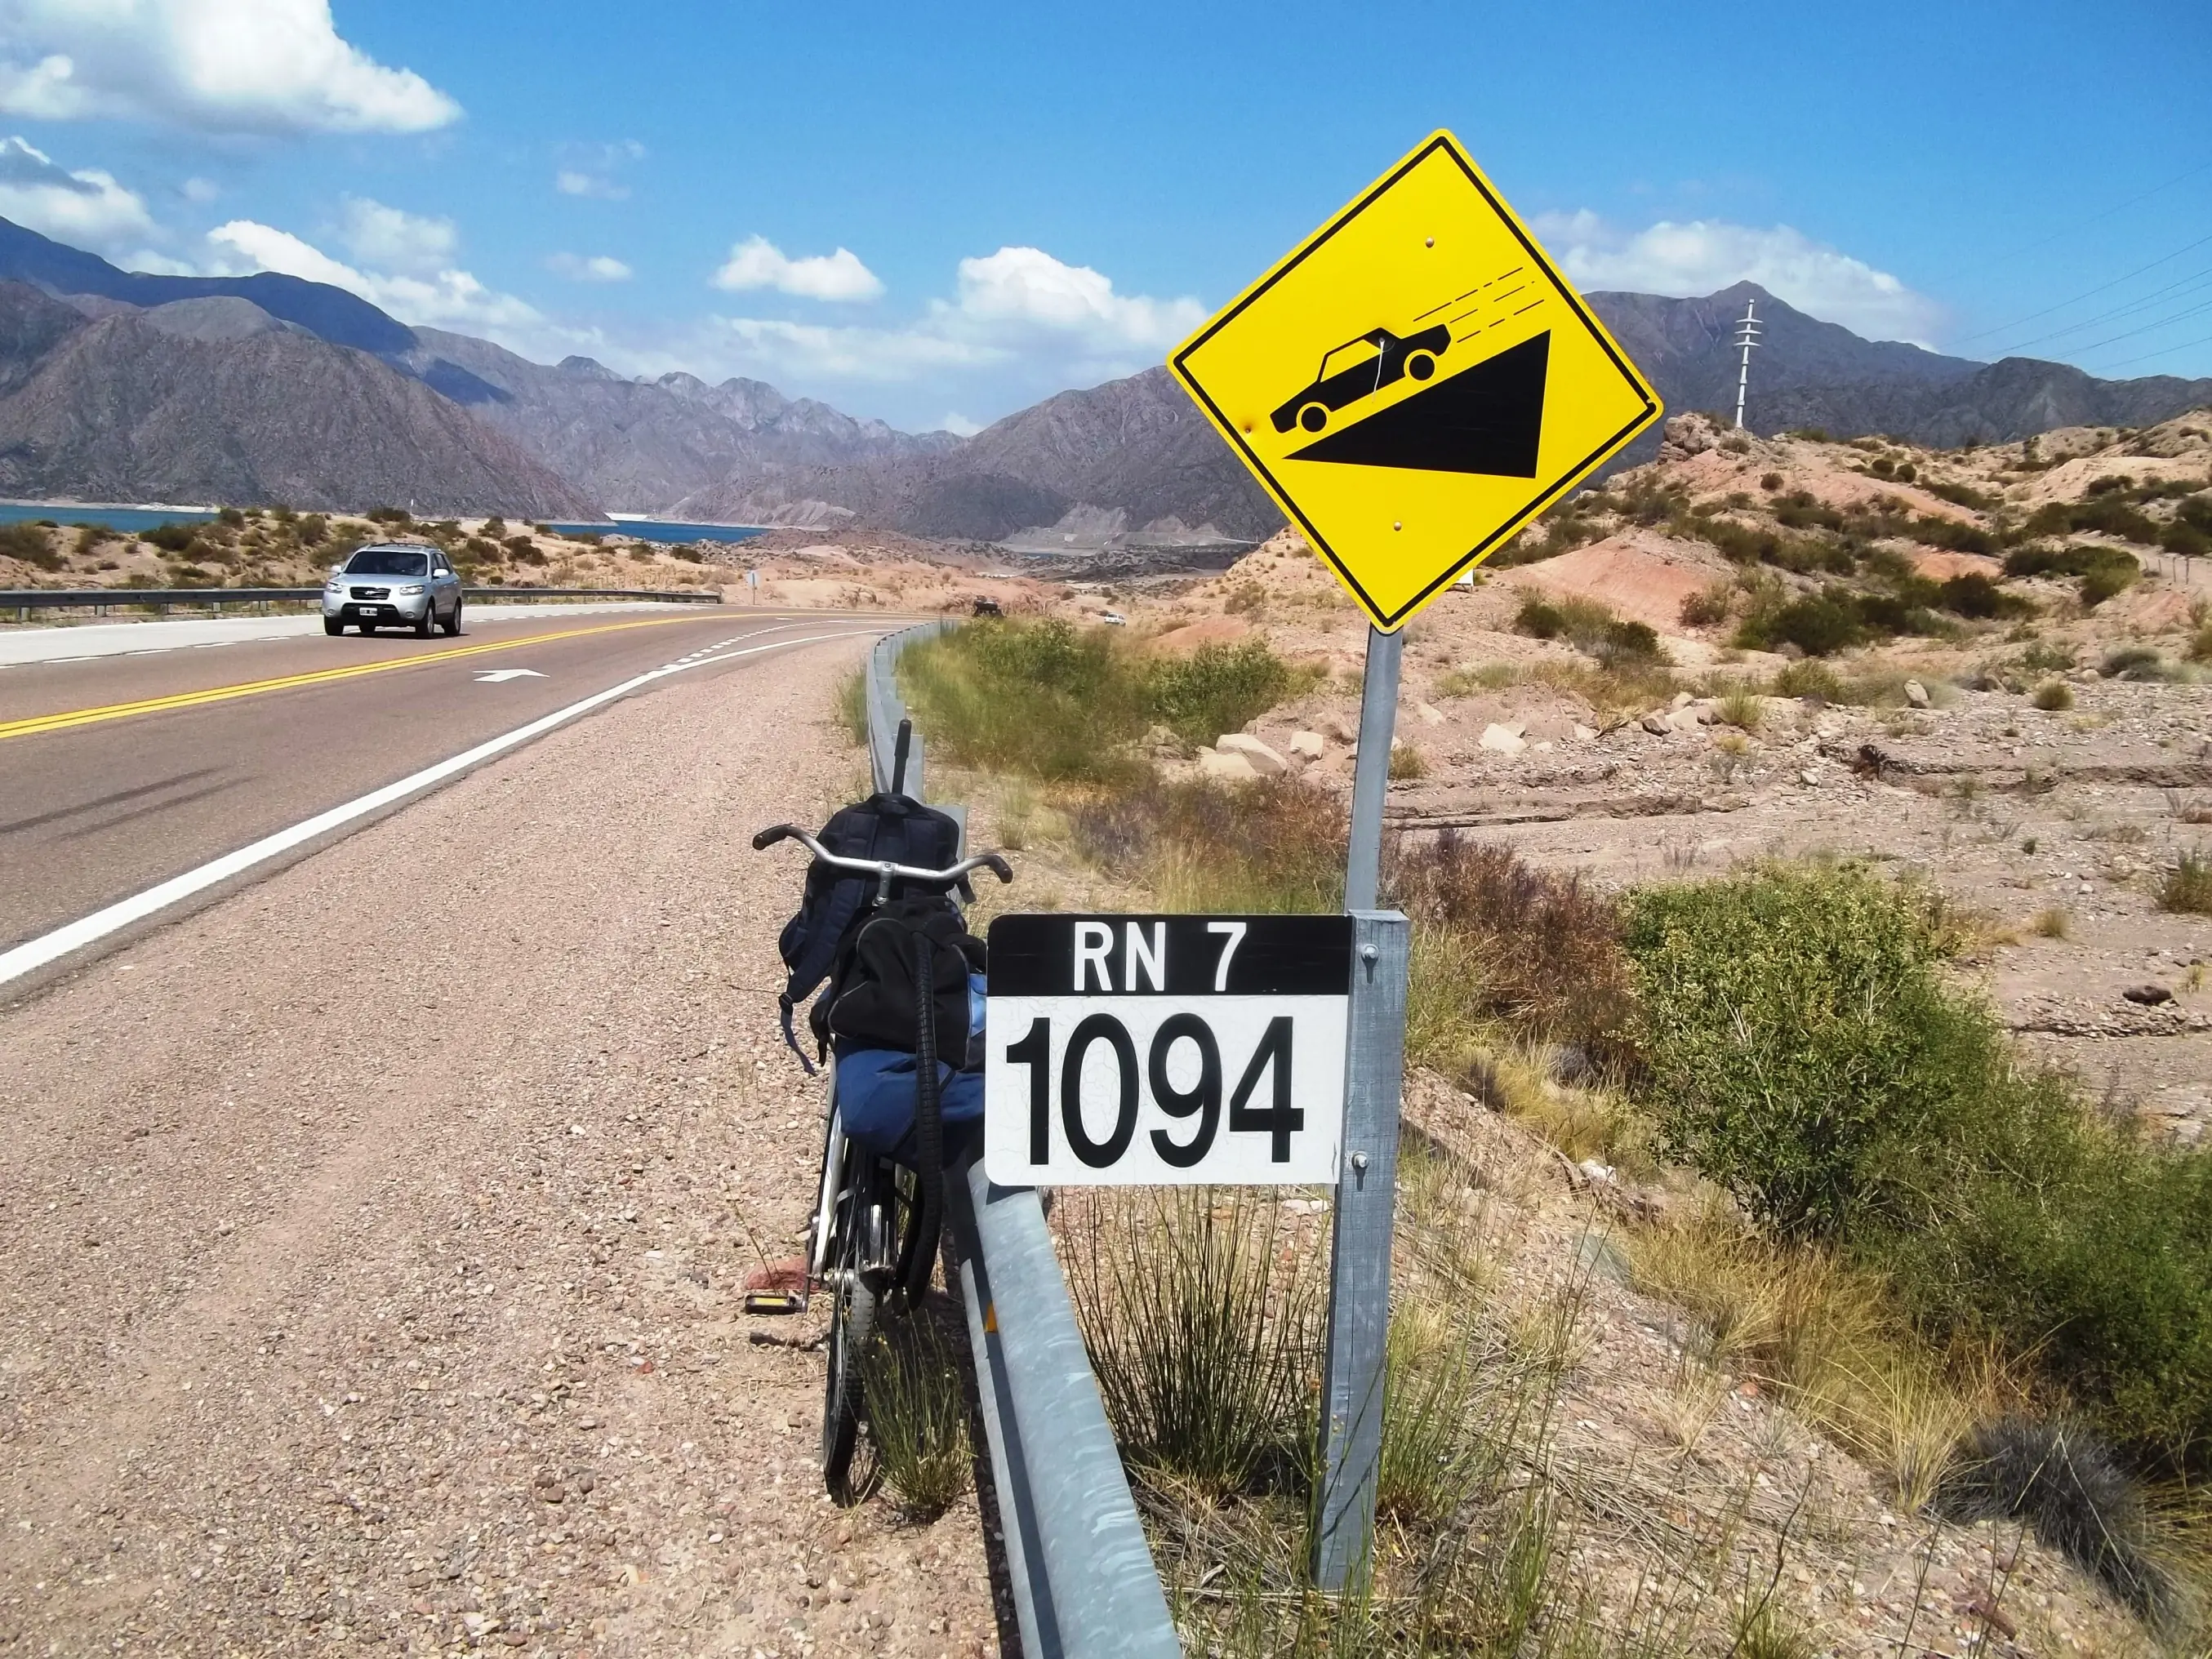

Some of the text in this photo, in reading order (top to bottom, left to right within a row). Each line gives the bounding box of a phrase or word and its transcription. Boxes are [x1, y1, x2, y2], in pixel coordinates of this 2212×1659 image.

[1074, 921, 1247, 992] RN 7
[1006, 1012, 1304, 1168] 1094
